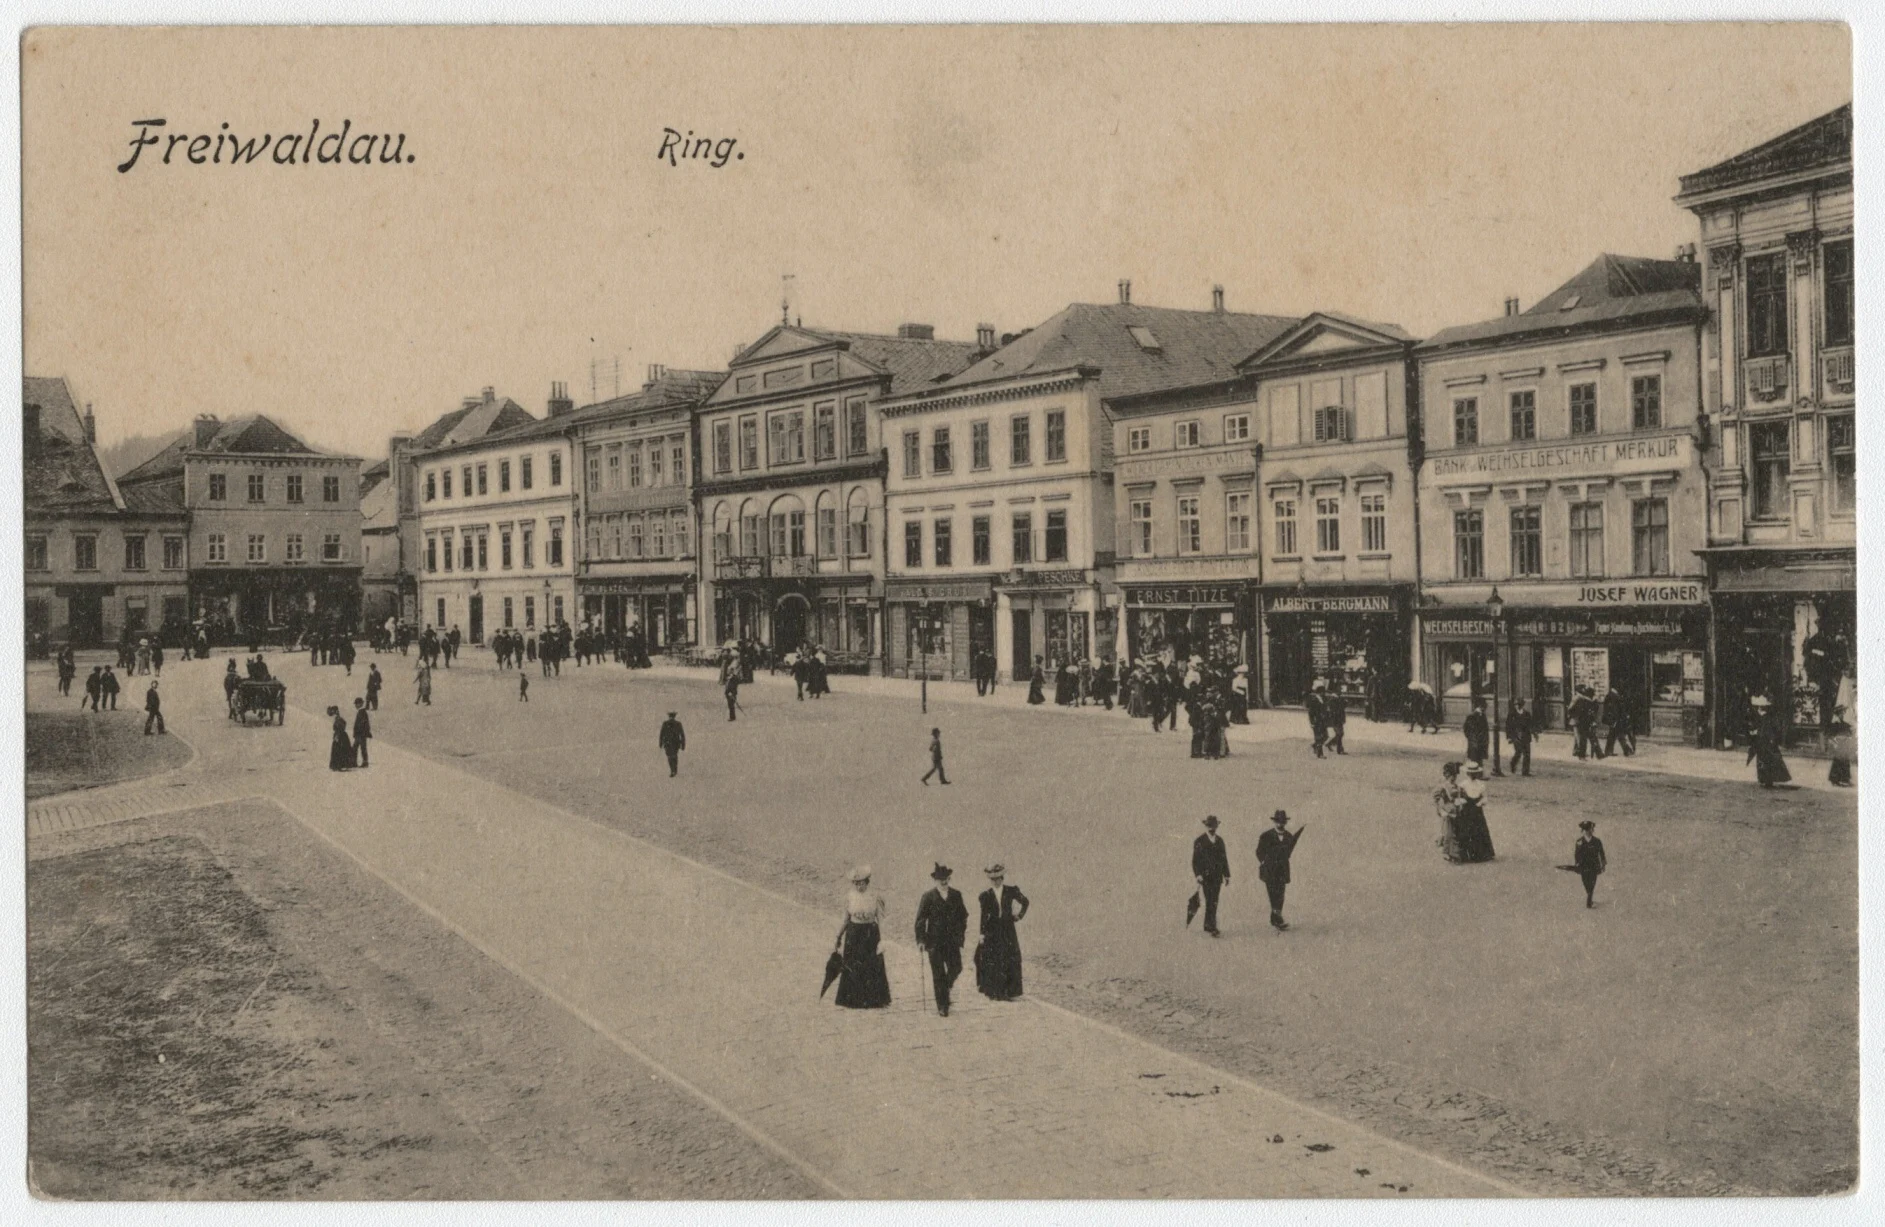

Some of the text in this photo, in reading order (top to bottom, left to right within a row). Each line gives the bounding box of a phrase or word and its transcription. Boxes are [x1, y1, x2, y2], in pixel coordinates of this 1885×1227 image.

[1435, 458, 1467, 475] BANK
[1616, 438, 1678, 460] MERKUR
[1137, 588, 1228, 602] ERNST TITZE
[1577, 586, 1698, 602] JOSEF WAGNER
[1273, 596, 1389, 610] ALBERT BERGMANN
